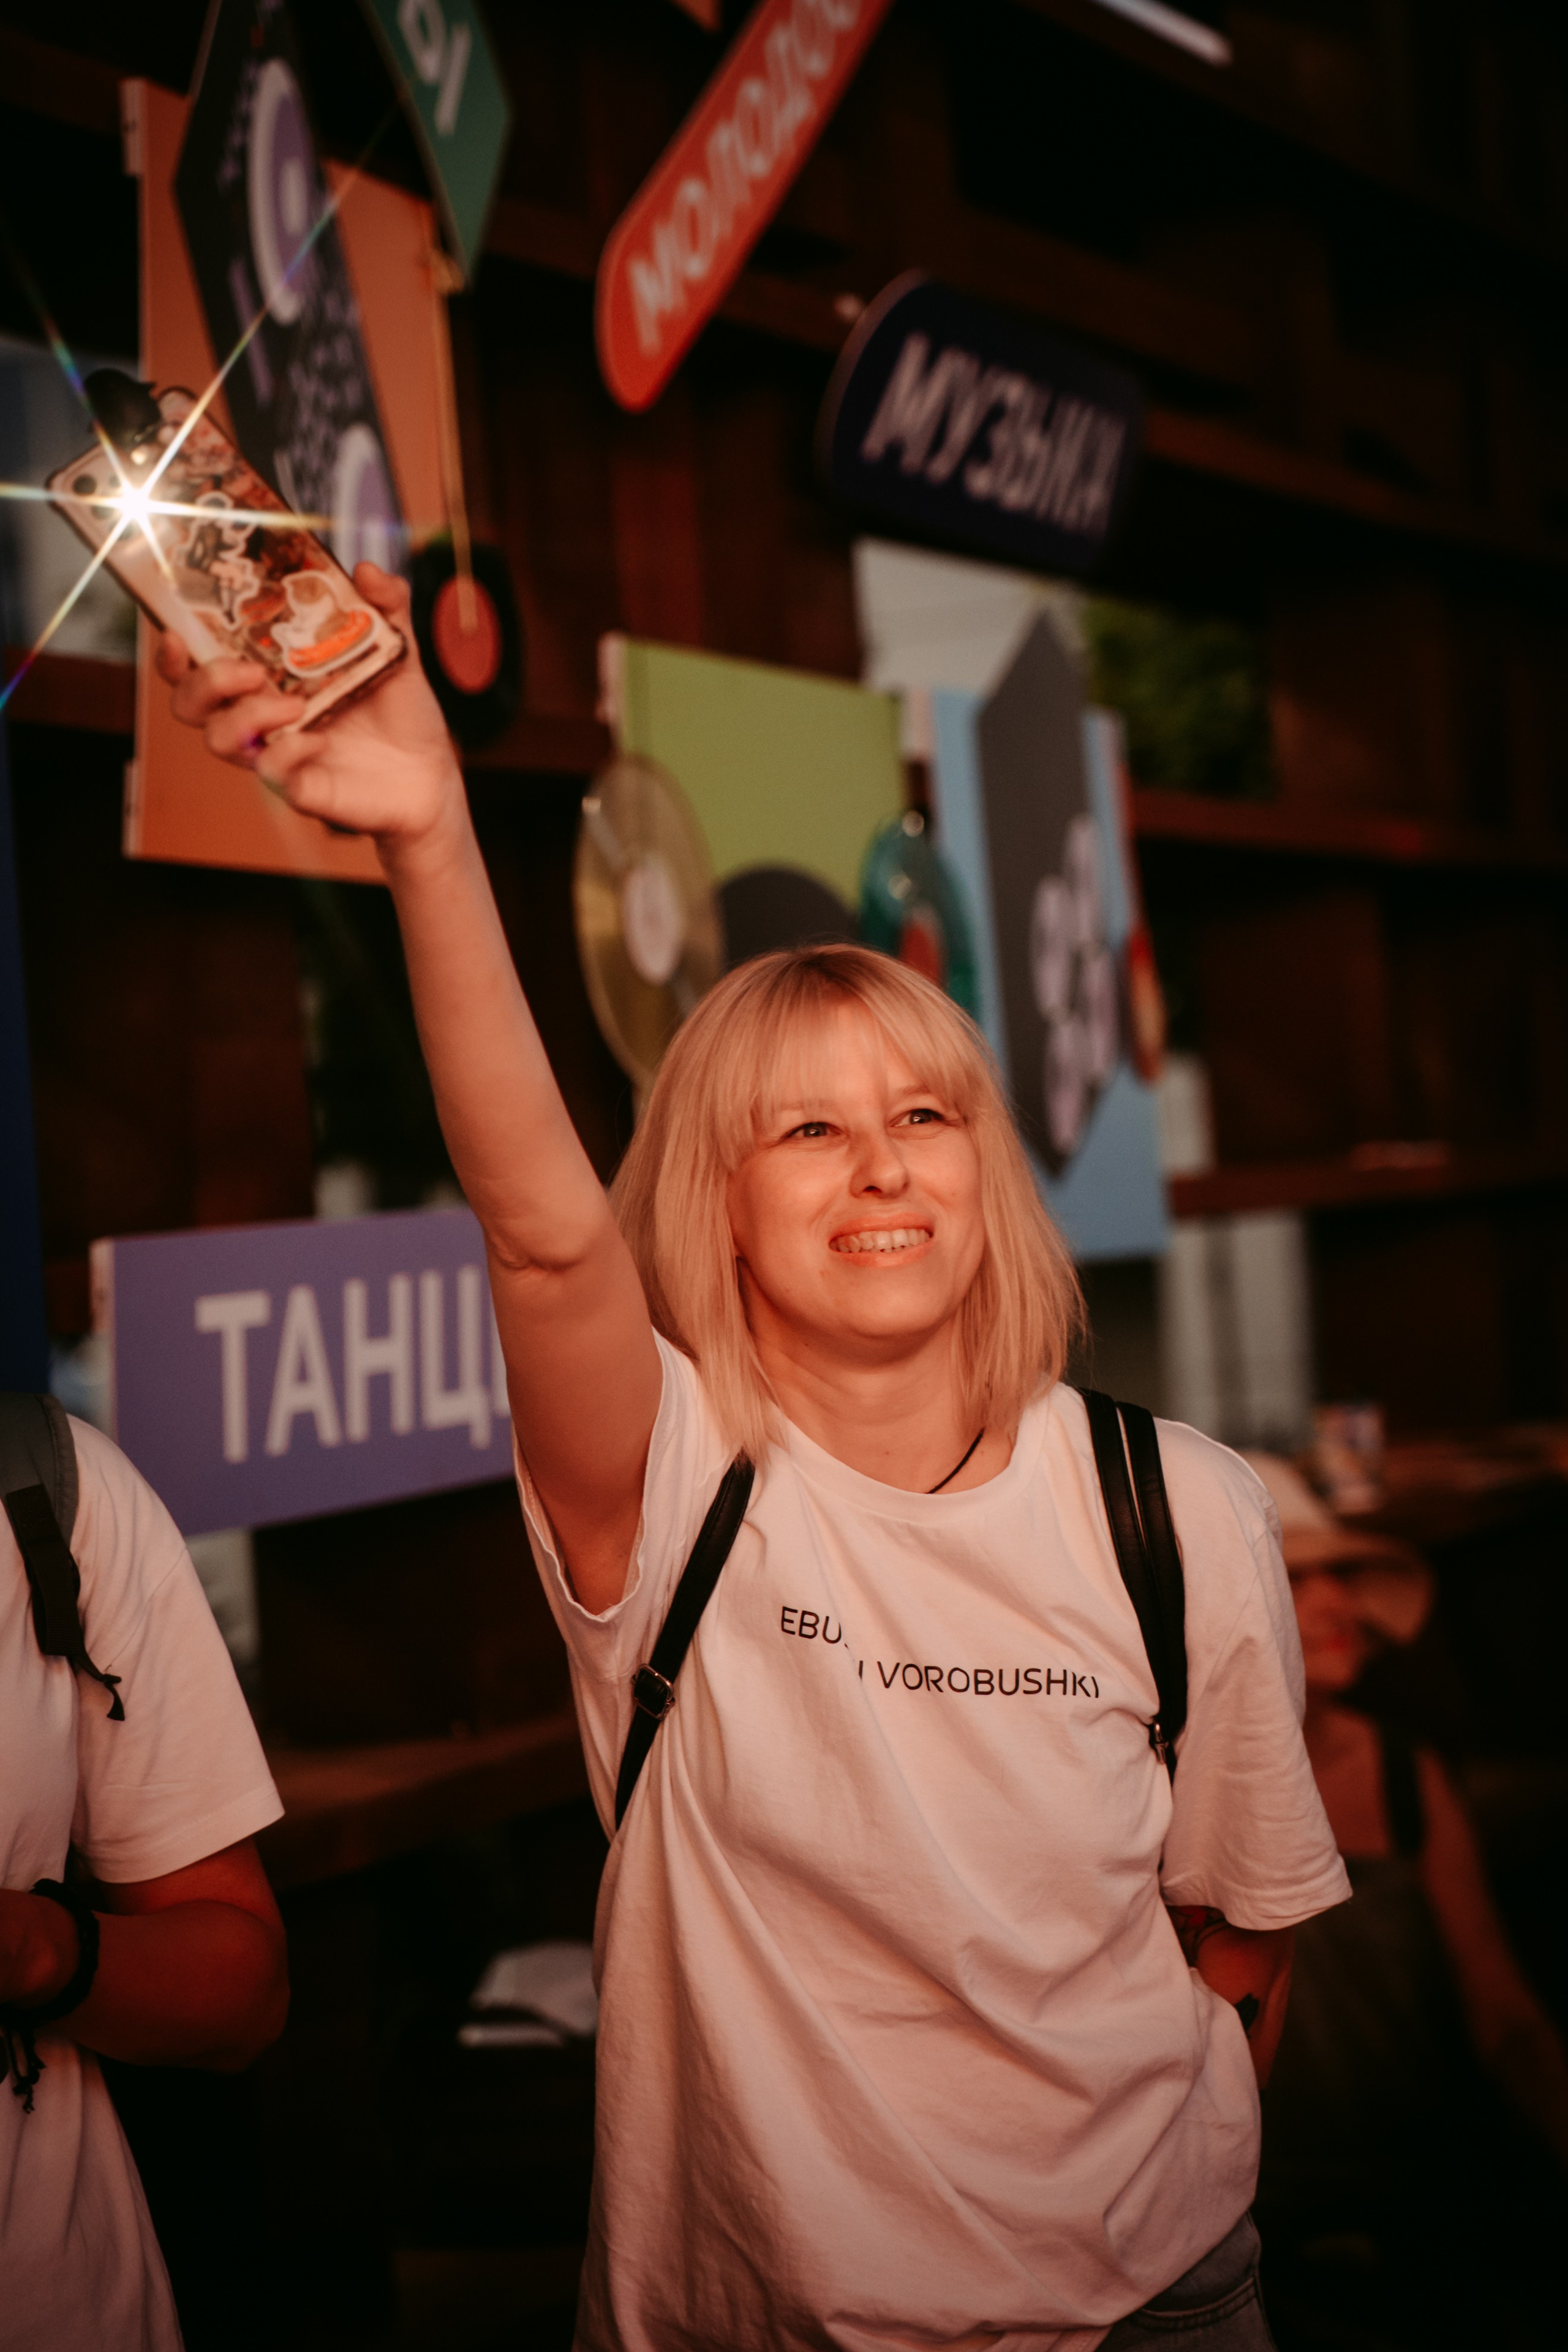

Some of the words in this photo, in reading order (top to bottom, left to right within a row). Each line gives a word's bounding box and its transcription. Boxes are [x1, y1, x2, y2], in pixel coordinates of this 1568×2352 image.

[860, 330, 1127, 541] МУЗЫКА
[194, 1264, 510, 1463] ТАНЦ
[876, 1660, 1099, 1698] VOROBUSHKI
